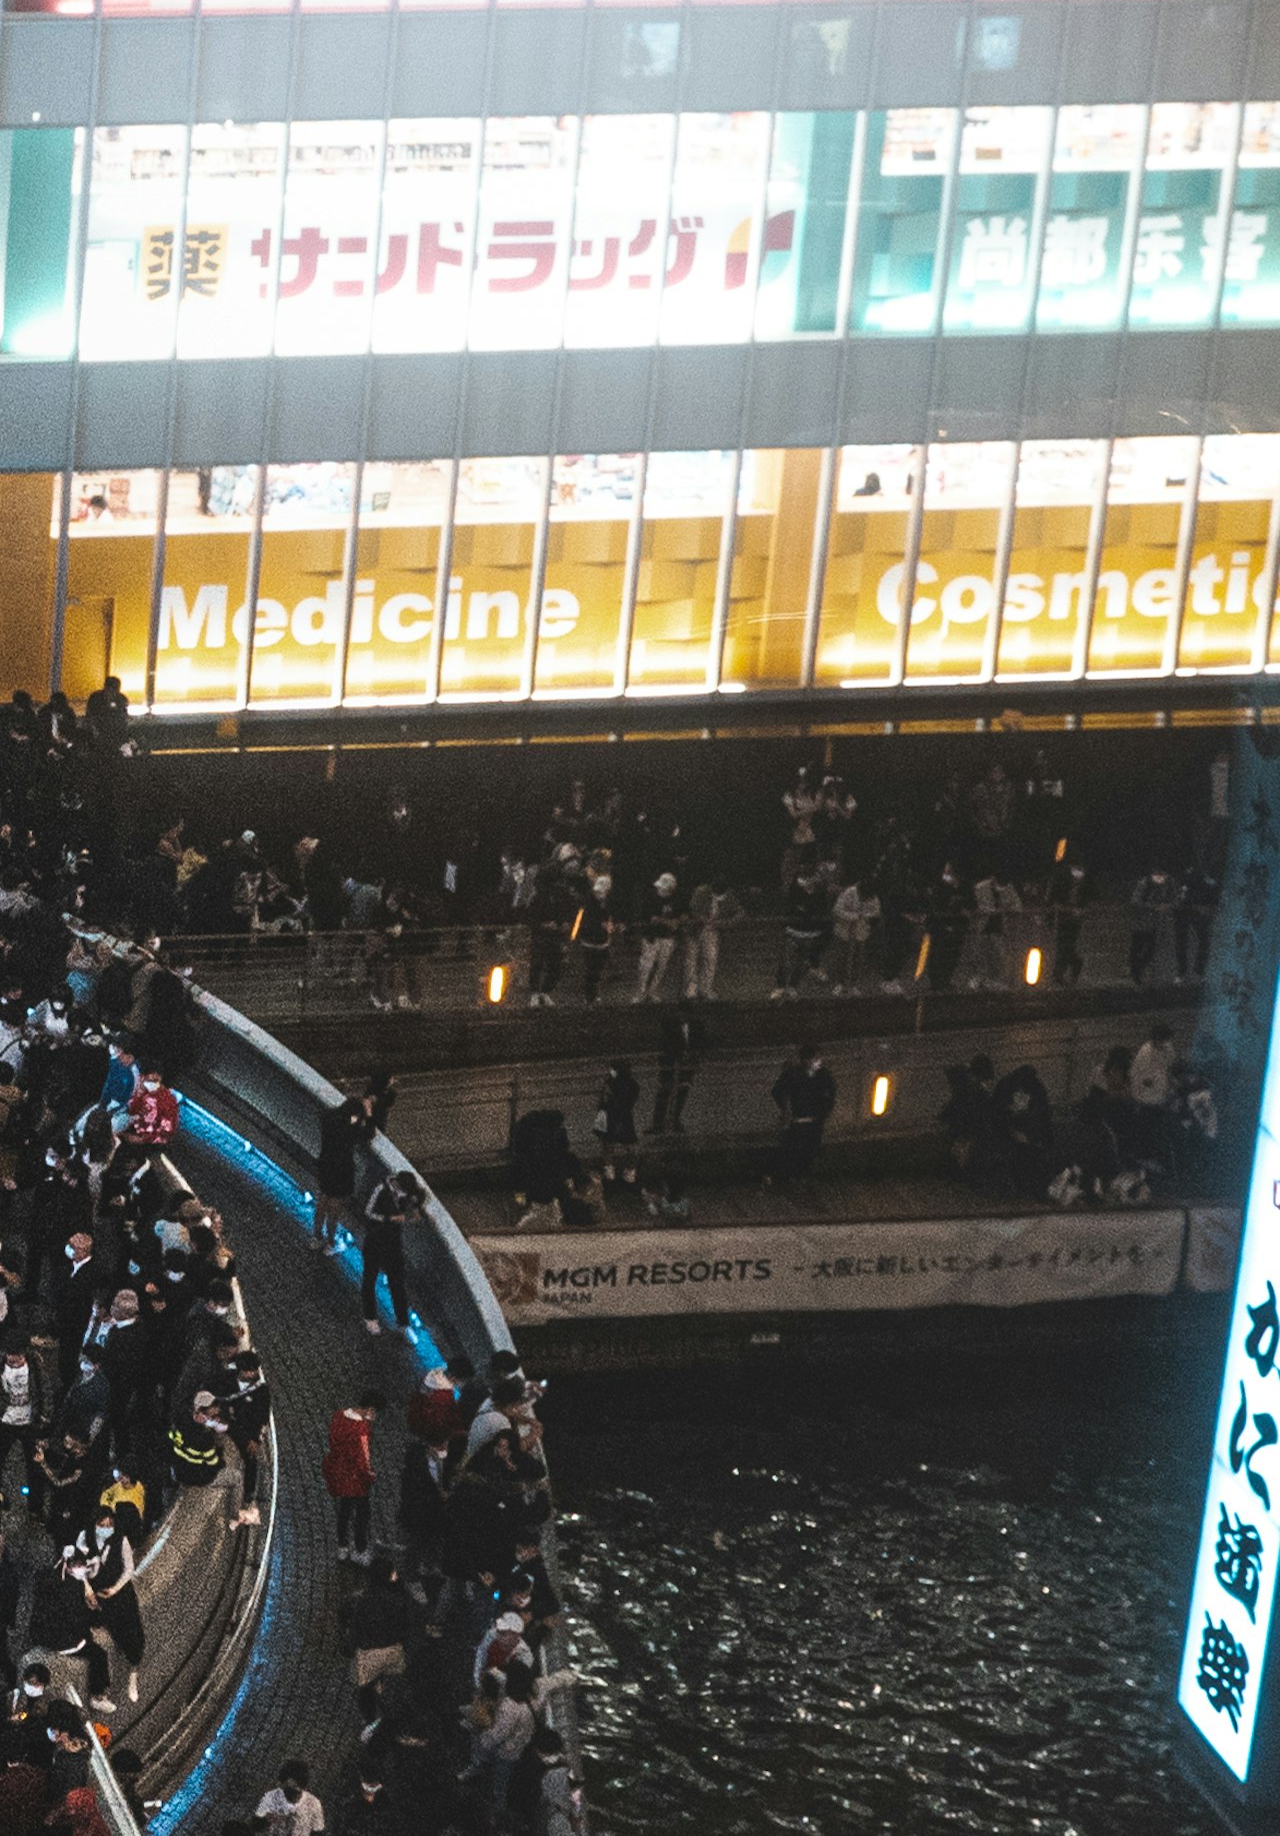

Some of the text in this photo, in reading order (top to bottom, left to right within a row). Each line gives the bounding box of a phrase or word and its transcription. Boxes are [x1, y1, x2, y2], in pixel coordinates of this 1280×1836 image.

[146, 228, 222, 301] 薬
[250, 215, 706, 299] サンドラッグ
[154, 576, 583, 652] Medicine
[543, 1257, 773, 1292] MGM RESORTS
[543, 1291, 594, 1306] JAPAN
